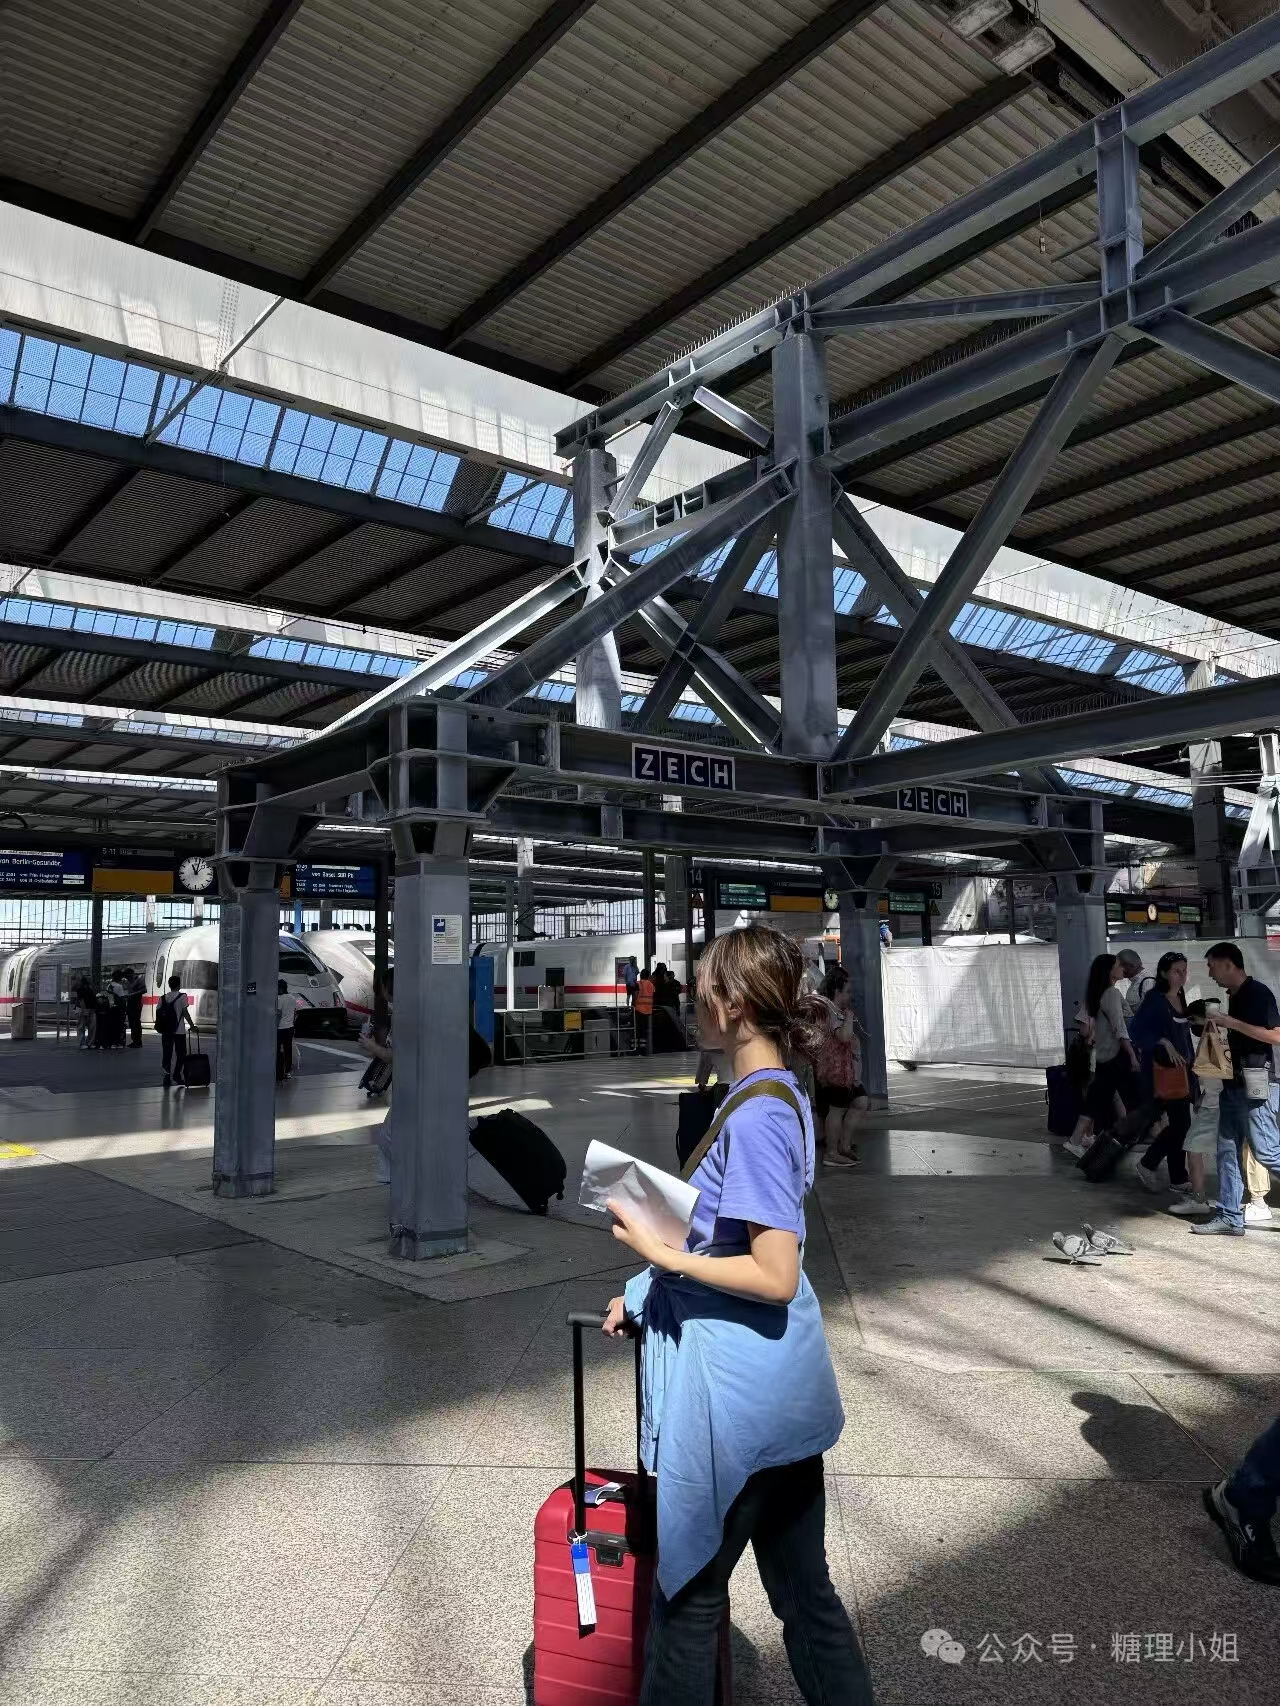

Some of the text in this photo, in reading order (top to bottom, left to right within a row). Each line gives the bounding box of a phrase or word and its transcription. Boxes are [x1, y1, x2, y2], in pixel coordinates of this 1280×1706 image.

[640, 753, 730, 787] ZECH
[903, 787, 965, 814] ZECH
[689, 869, 703, 884] 14
